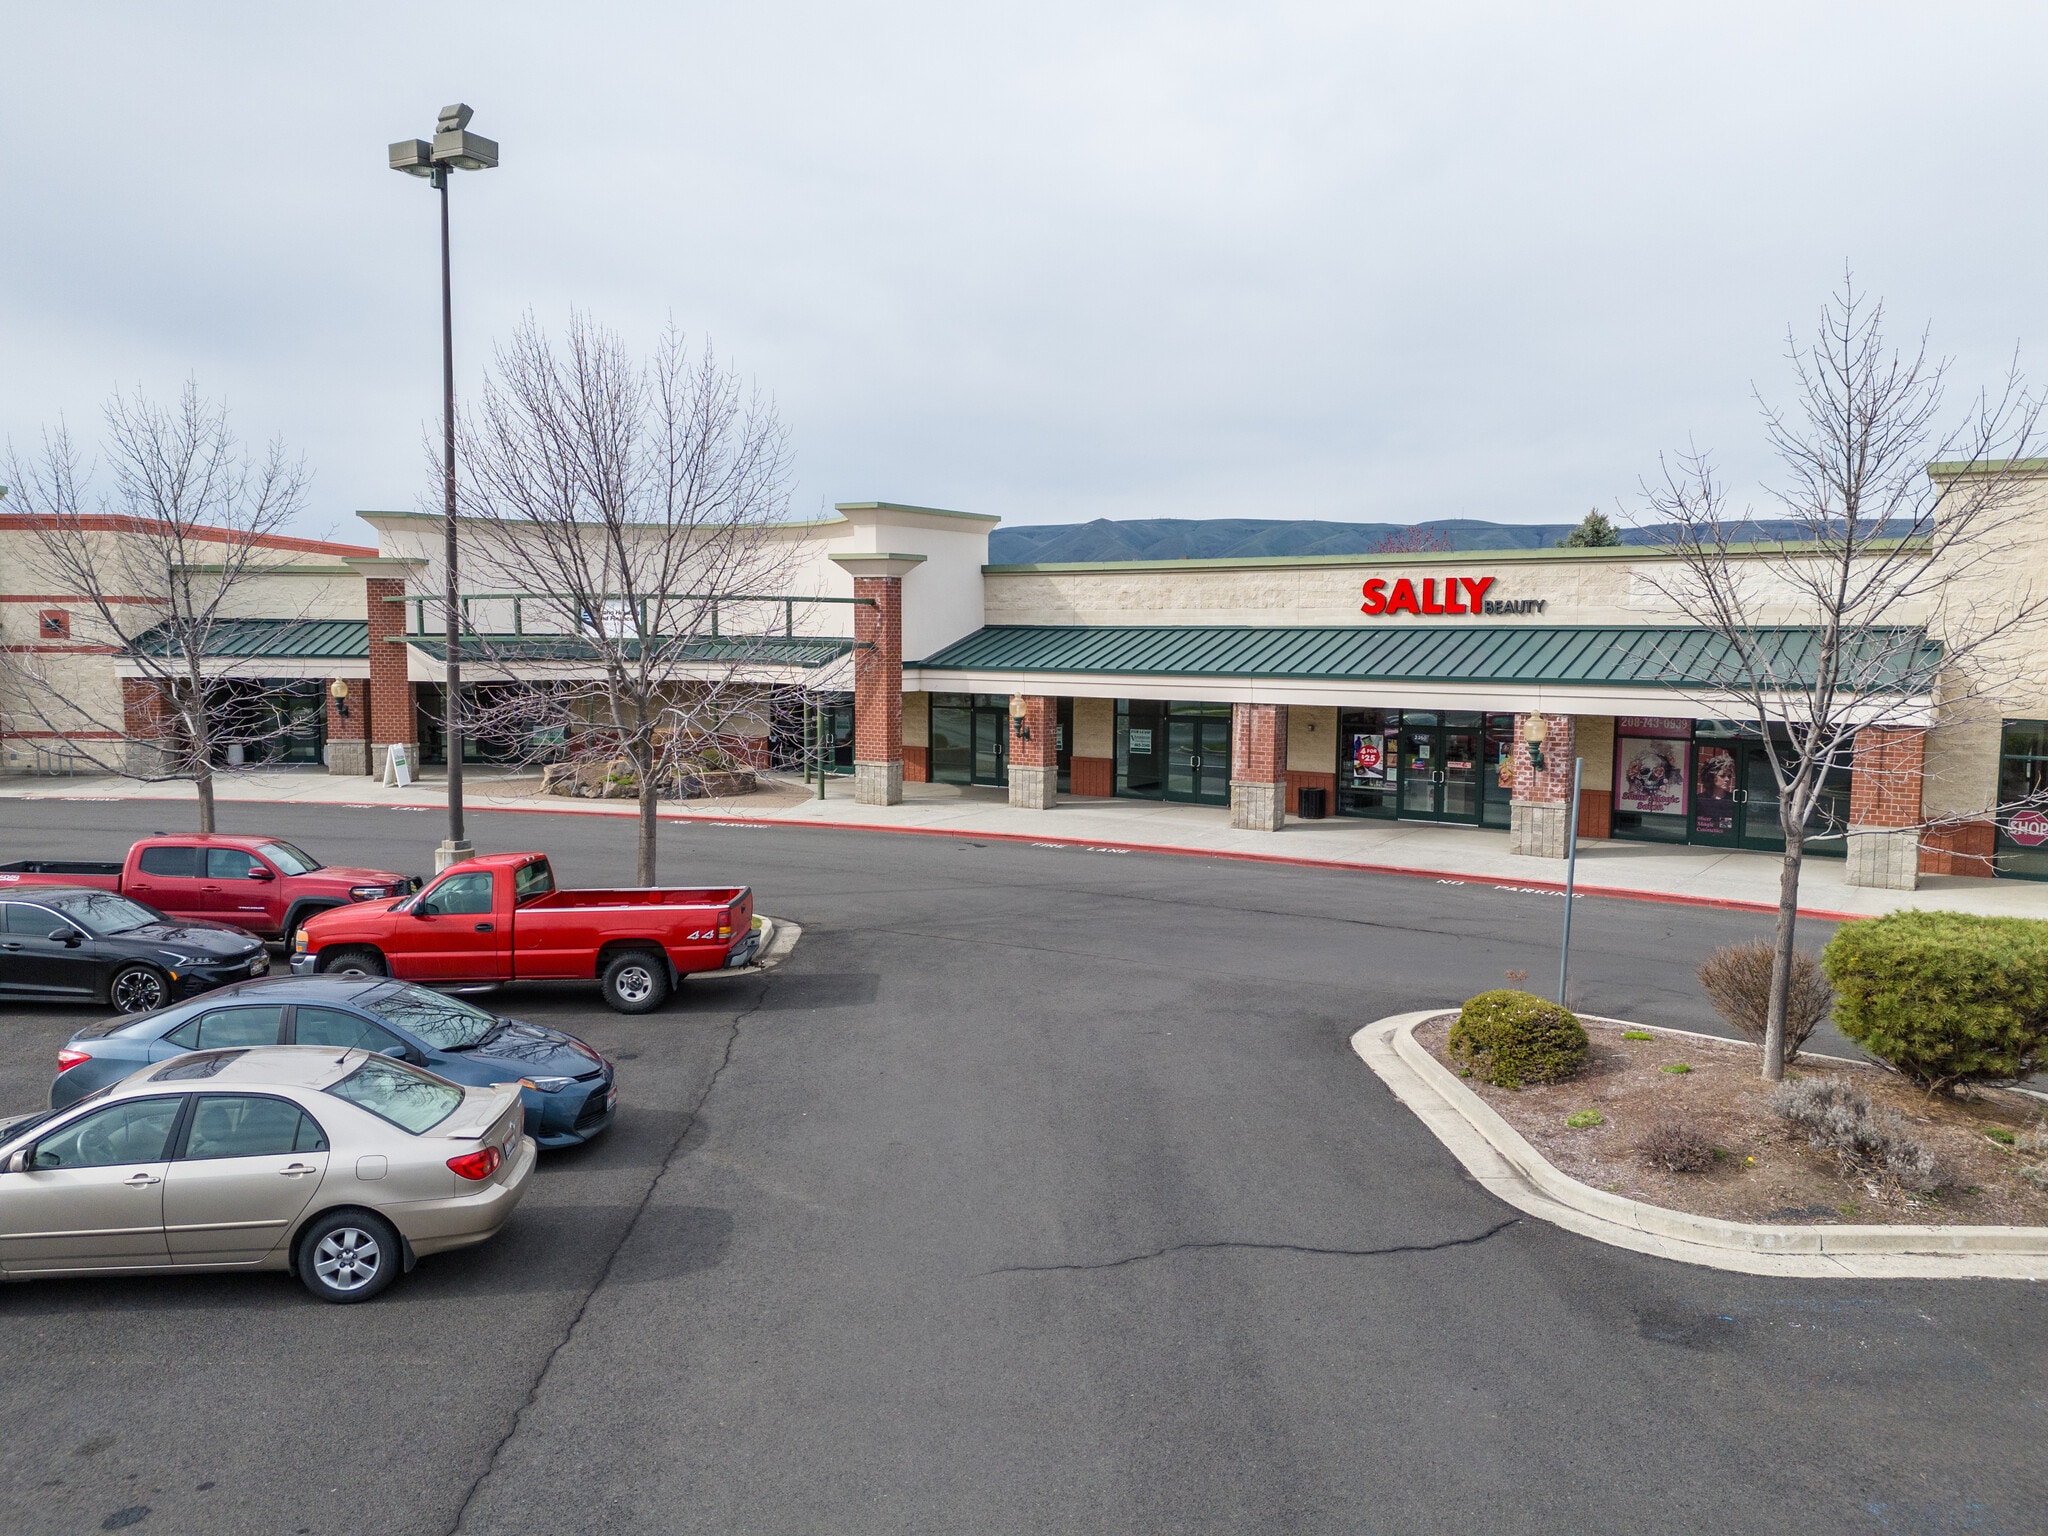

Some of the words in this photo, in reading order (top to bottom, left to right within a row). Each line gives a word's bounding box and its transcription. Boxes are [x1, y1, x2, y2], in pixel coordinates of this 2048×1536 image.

[1361, 577, 1495, 614] SALLY
[1484, 600, 1546, 614] BEAUTY
[1360, 747, 1366, 755] 4
[1361, 754, 1376, 762] $25
[2010, 820, 2048, 836] SHOP
[1086, 846, 1132, 854] LANE
[1436, 878, 1465, 886] NO
[1494, 885, 1585, 898] PARKING
